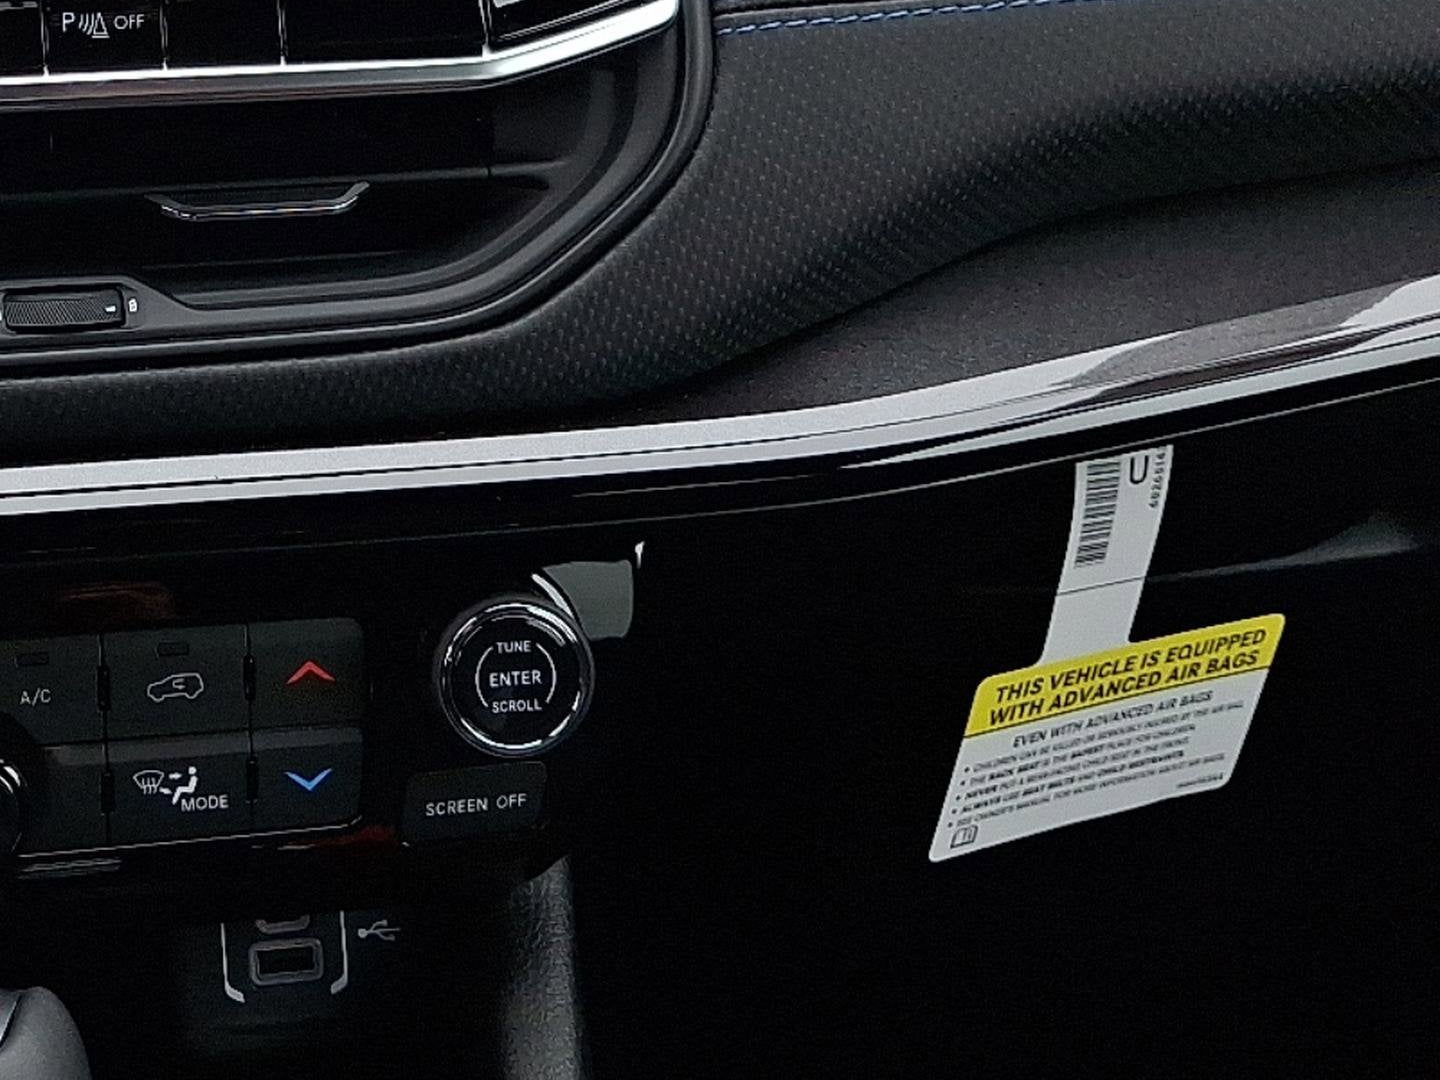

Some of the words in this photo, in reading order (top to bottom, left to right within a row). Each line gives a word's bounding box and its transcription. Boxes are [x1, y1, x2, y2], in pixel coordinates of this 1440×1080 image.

[114, 14, 144, 29] OFF
[497, 641, 530, 653] TUNE
[997, 678, 1044, 703] THIS
[1050, 656, 1134, 689] VEHICLE
[1140, 650, 1161, 670] IS
[1165, 629, 1266, 663] EQUIPPED
[490, 670, 541, 687] ENTER
[21, 688, 50, 705] A/C
[990, 698, 1044, 726] WITH
[1048, 671, 1161, 712] ADVANCED
[1165, 662, 1200, 682] AIR
[1206, 650, 1260, 674] BAGS
[493, 699, 541, 713] SCROLL
[1013, 730, 1048, 748] EVEN
[1051, 720, 1084, 739] WITH
[1156, 697, 1177, 711] AIR
[181, 794, 228, 811] MODE
[426, 798, 487, 816] SCREEN
[497, 793, 527, 809] OFF
